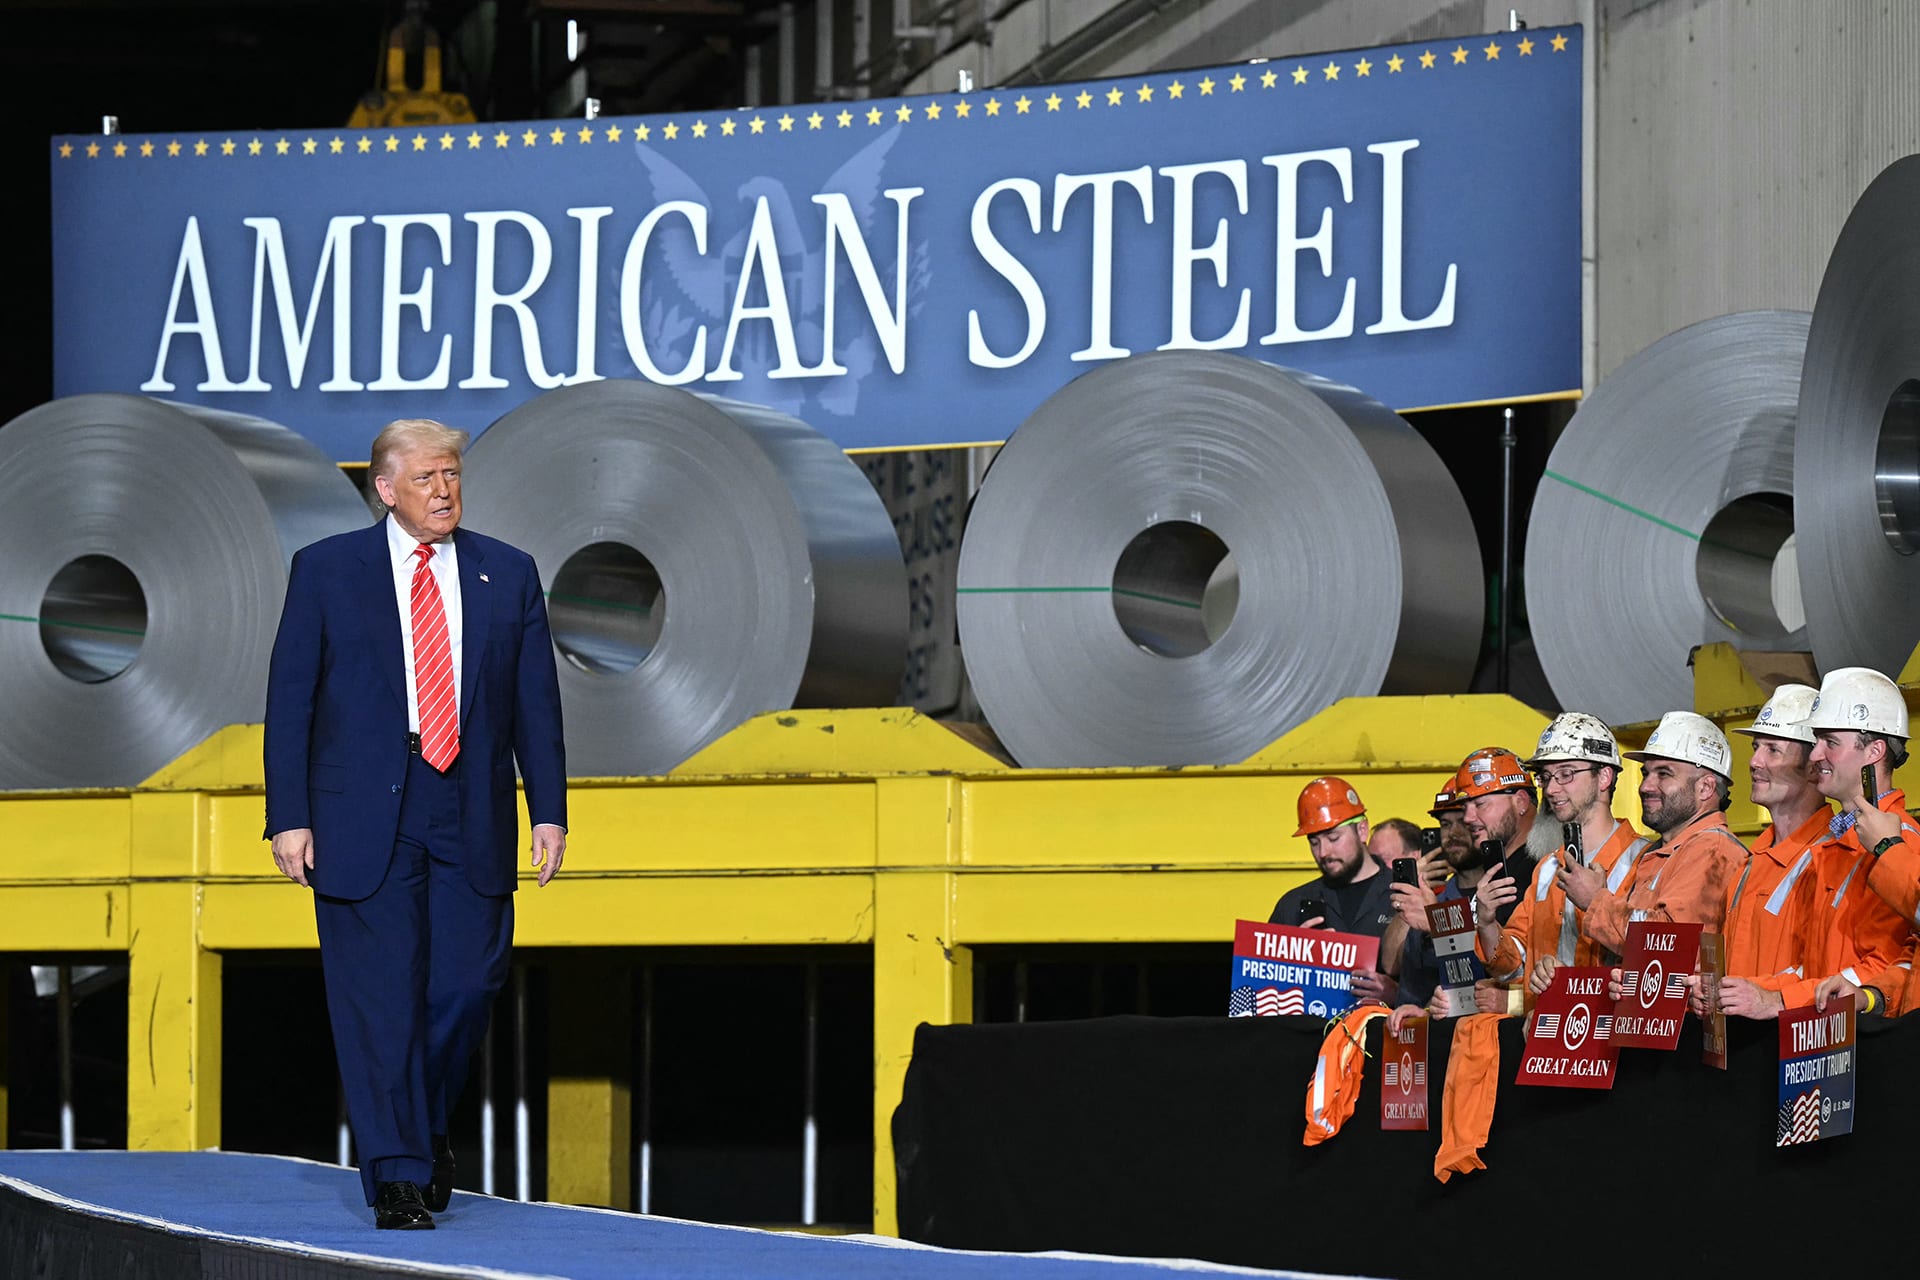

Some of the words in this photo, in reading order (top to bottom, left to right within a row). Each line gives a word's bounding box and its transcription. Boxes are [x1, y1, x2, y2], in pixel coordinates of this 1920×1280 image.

[140, 186, 924, 392] AMERICAN
[968, 138, 1458, 368] STEEL
[1448, 905, 1465, 930] JOBS
[1254, 931, 1316, 963] THANK
[1320, 940, 1357, 968] YOU
[1644, 933, 1677, 951] MAKE
[1242, 959, 1312, 985] PRESIDENT
[1315, 970, 1363, 991] TRUM
[1566, 978, 1603, 995] MAKE
[1643, 973, 1660, 999] USS
[1568, 1015, 1587, 1039] USS
[1615, 1016, 1643, 1034] GREAT
[1643, 1018, 1678, 1037] AGAIN
[1791, 1016, 1828, 1053] THANK
[1829, 1011, 1847, 1045] YOU
[1526, 1056, 1569, 1075] GREAT
[1569, 1058, 1611, 1076] AGAIN
[1785, 1057, 1826, 1085] PRESIDENT
[1826, 1050, 1851, 1077] TRUMP!
[1384, 1103, 1407, 1120] GREAT
